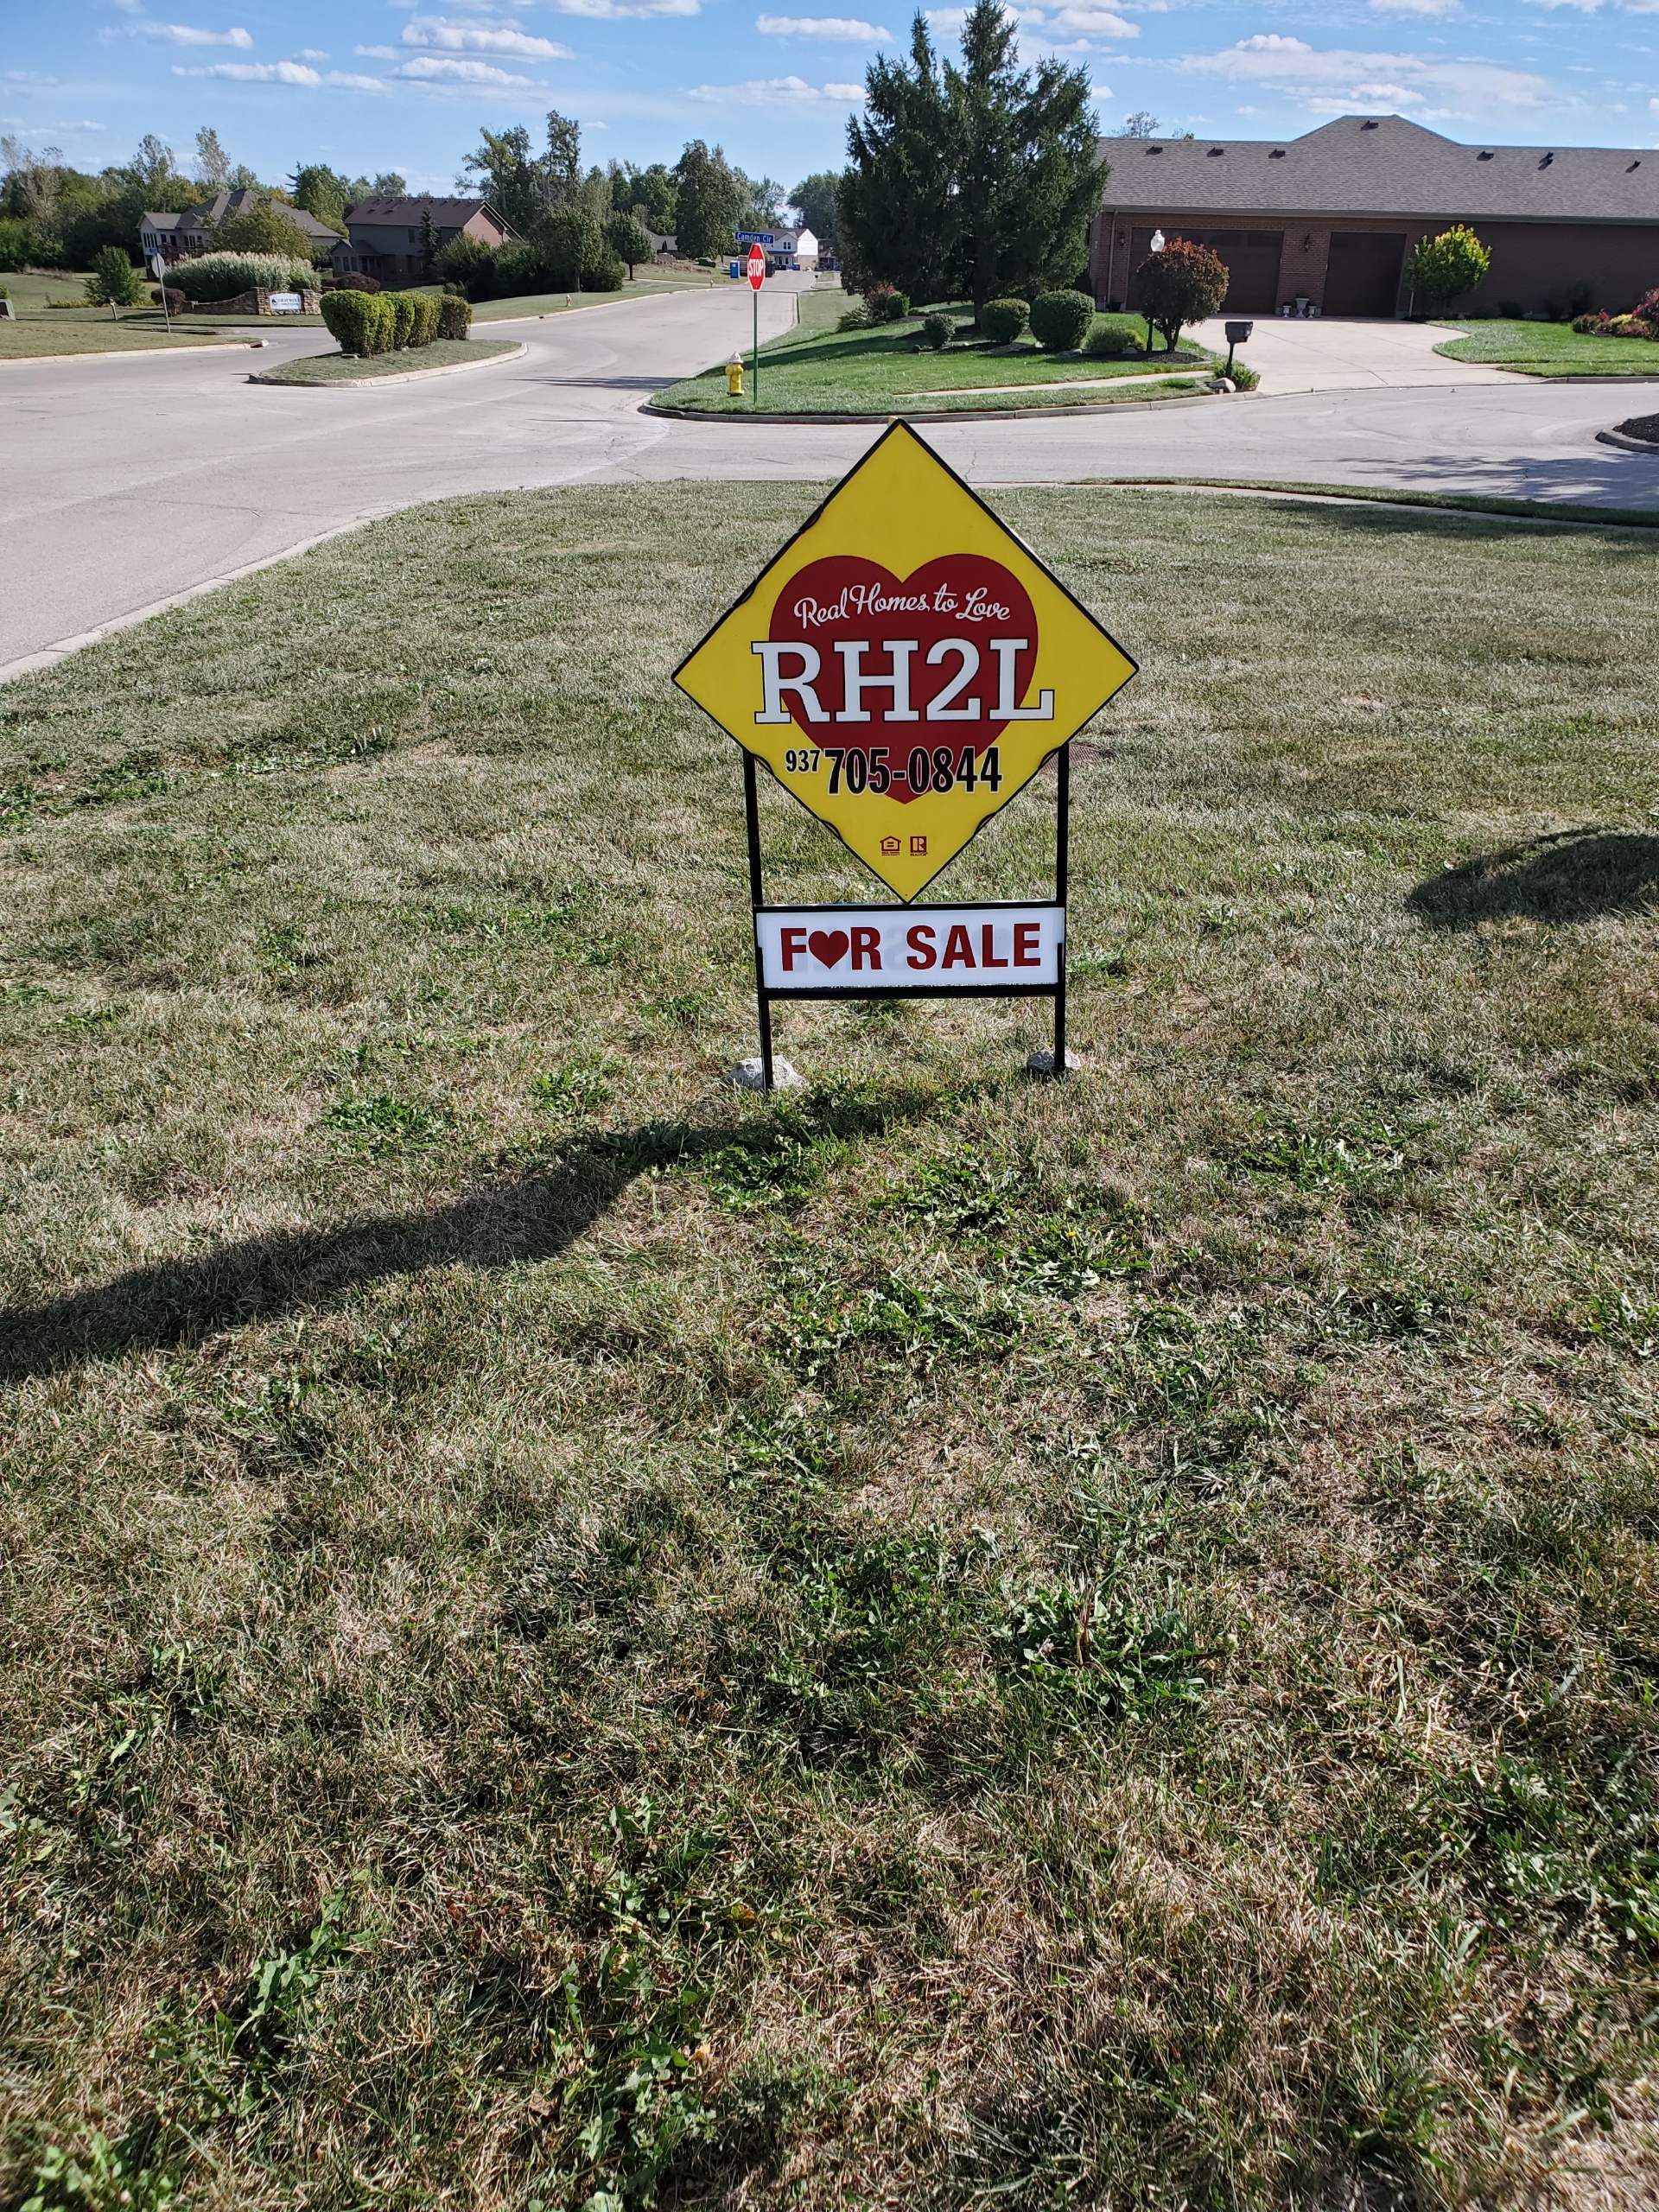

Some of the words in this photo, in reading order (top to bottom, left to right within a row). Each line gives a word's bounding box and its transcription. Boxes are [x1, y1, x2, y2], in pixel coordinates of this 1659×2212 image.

[737, 232, 760, 242] Camden
[763, 234, 772, 243] Cir
[748, 258, 764, 277] STOP
[793, 587, 850, 629] Real
[849, 582, 931, 616] Homes
[933, 582, 959, 613] to
[955, 587, 1011, 622] Love
[750, 637, 1055, 725] RH2L
[785, 749, 821, 773] 937
[823, 746, 1003, 795] 705-0844
[906, 922, 1042, 971] SALE
